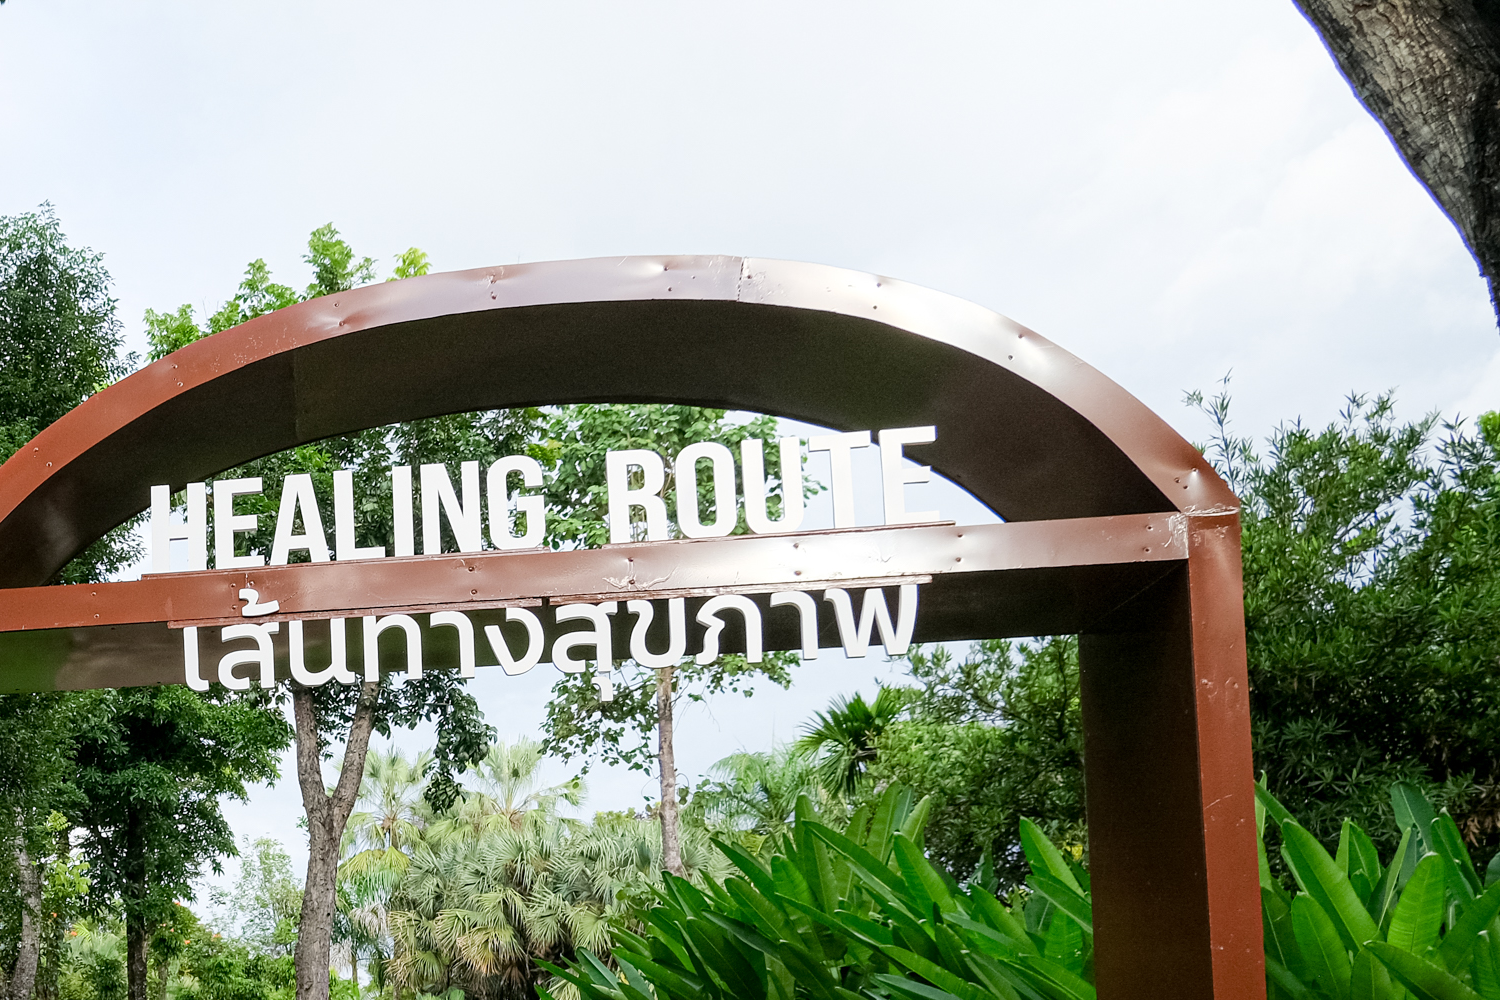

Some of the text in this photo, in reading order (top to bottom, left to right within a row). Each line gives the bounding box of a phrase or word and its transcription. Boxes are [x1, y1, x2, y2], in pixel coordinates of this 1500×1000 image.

[150, 425, 940, 573] HEALING ROUTE
[183, 584, 919, 702] เส้นทางสุขภาพ
